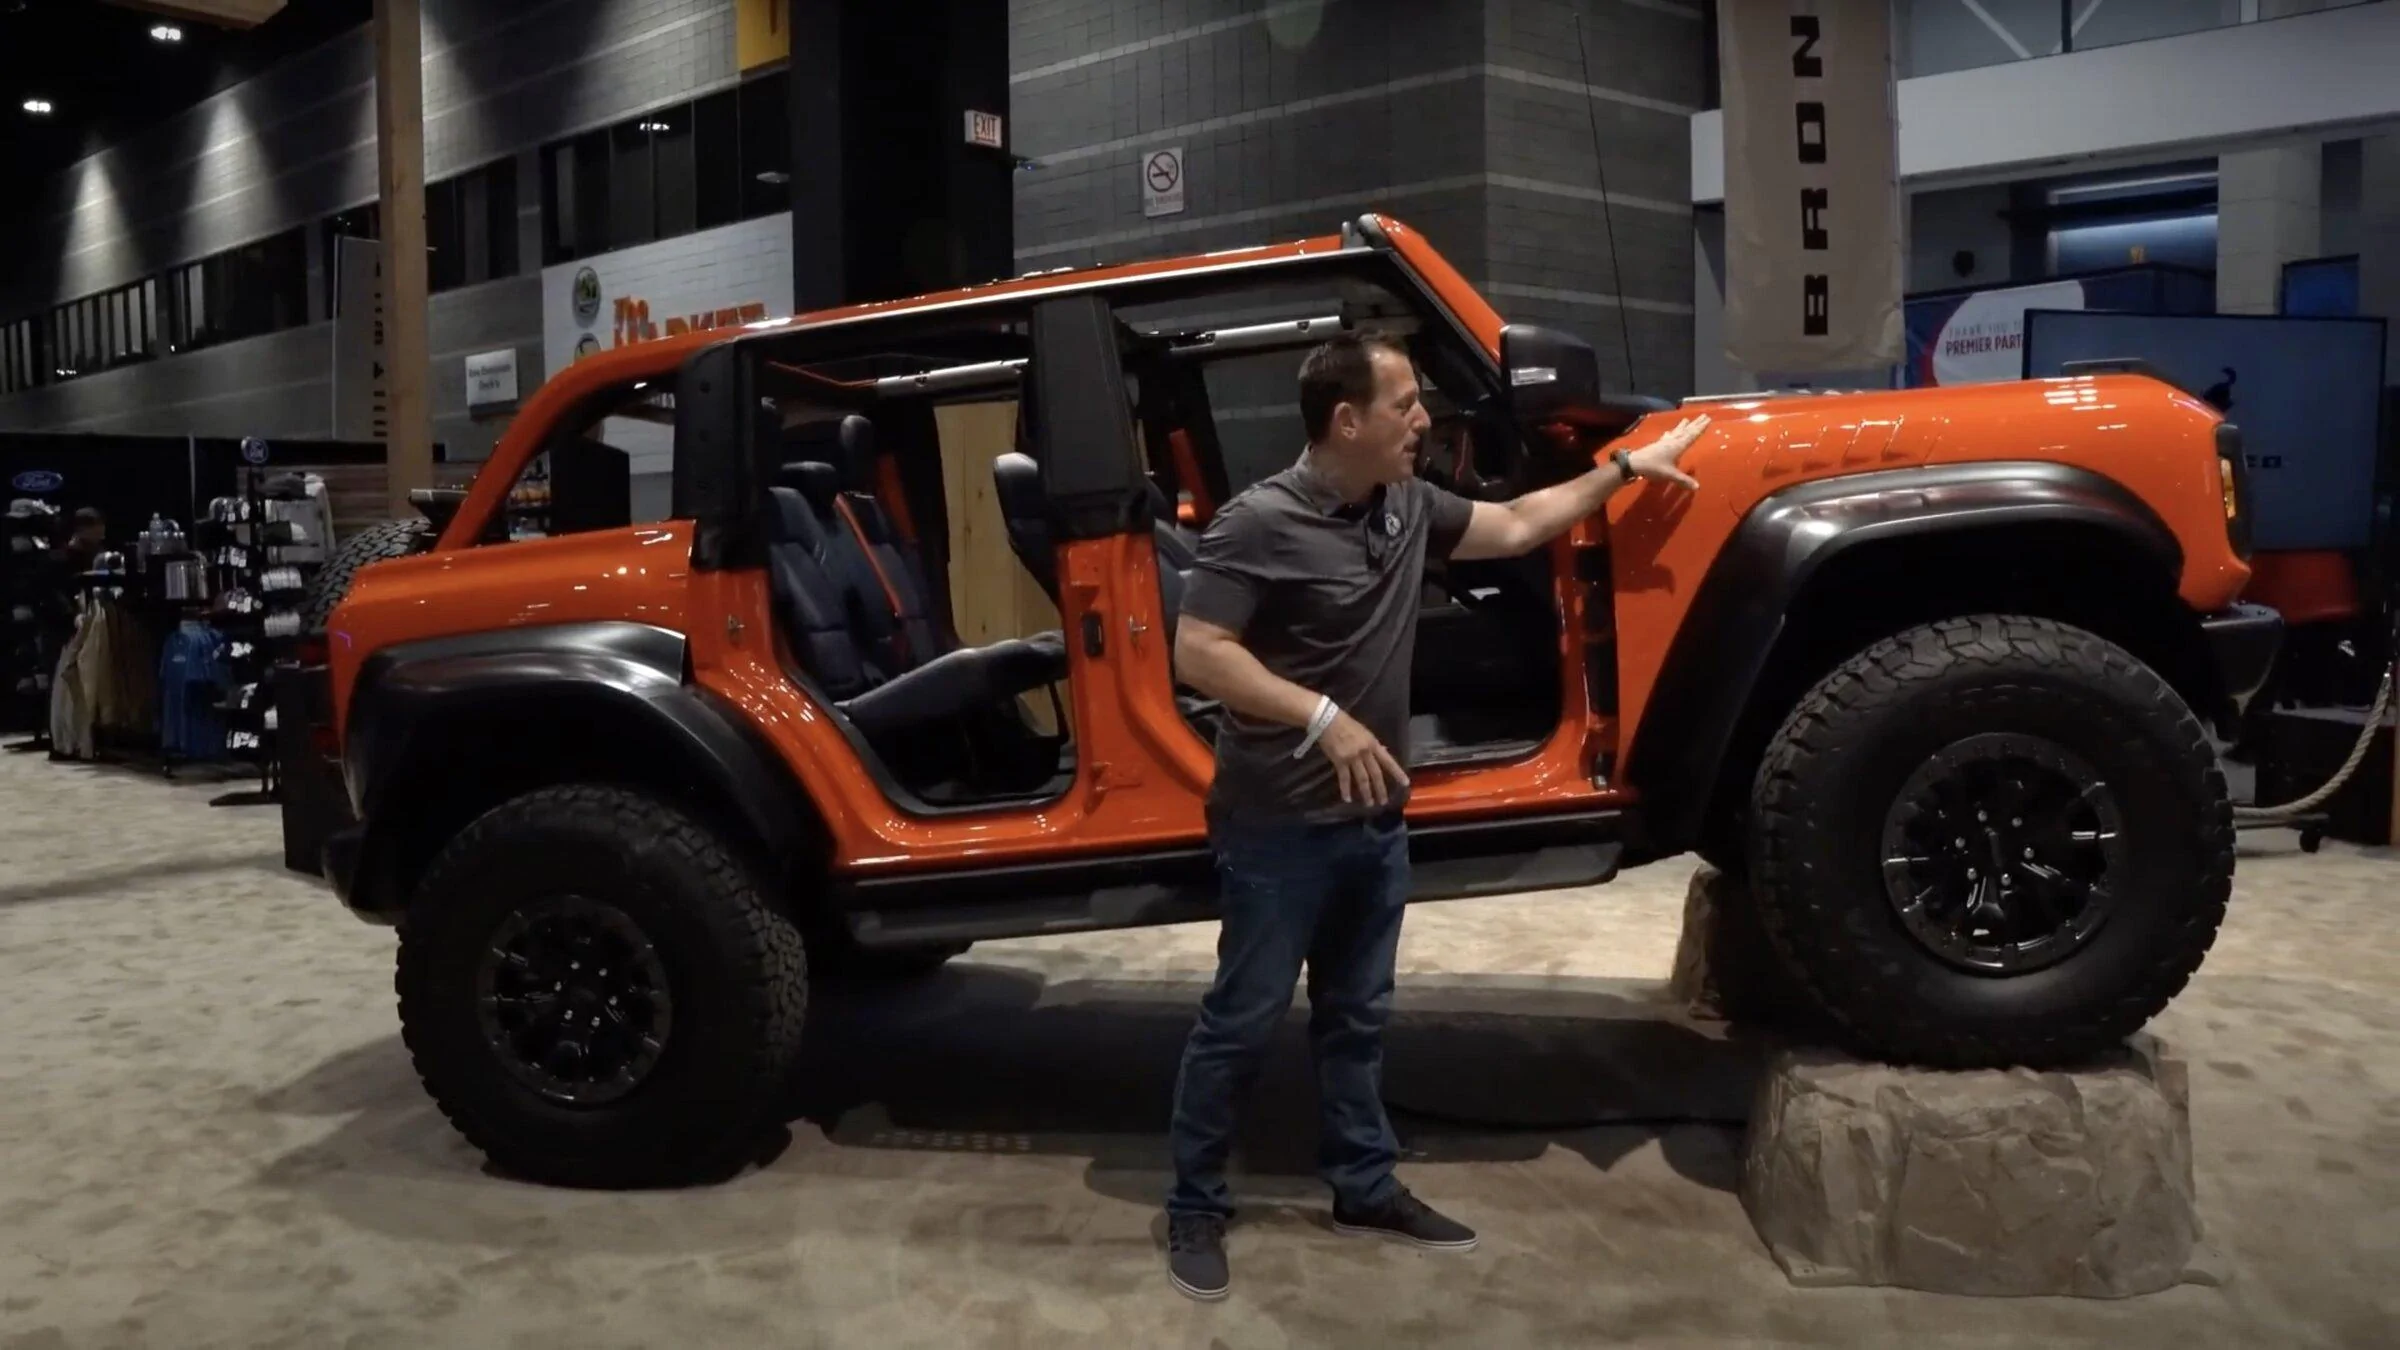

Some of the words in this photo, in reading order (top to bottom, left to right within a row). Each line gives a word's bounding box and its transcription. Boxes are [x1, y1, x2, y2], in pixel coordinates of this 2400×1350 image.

[974, 113, 997, 139] EXIT
[1946, 336, 1992, 357] PREMIER
[1994, 333, 2024, 352] PART
